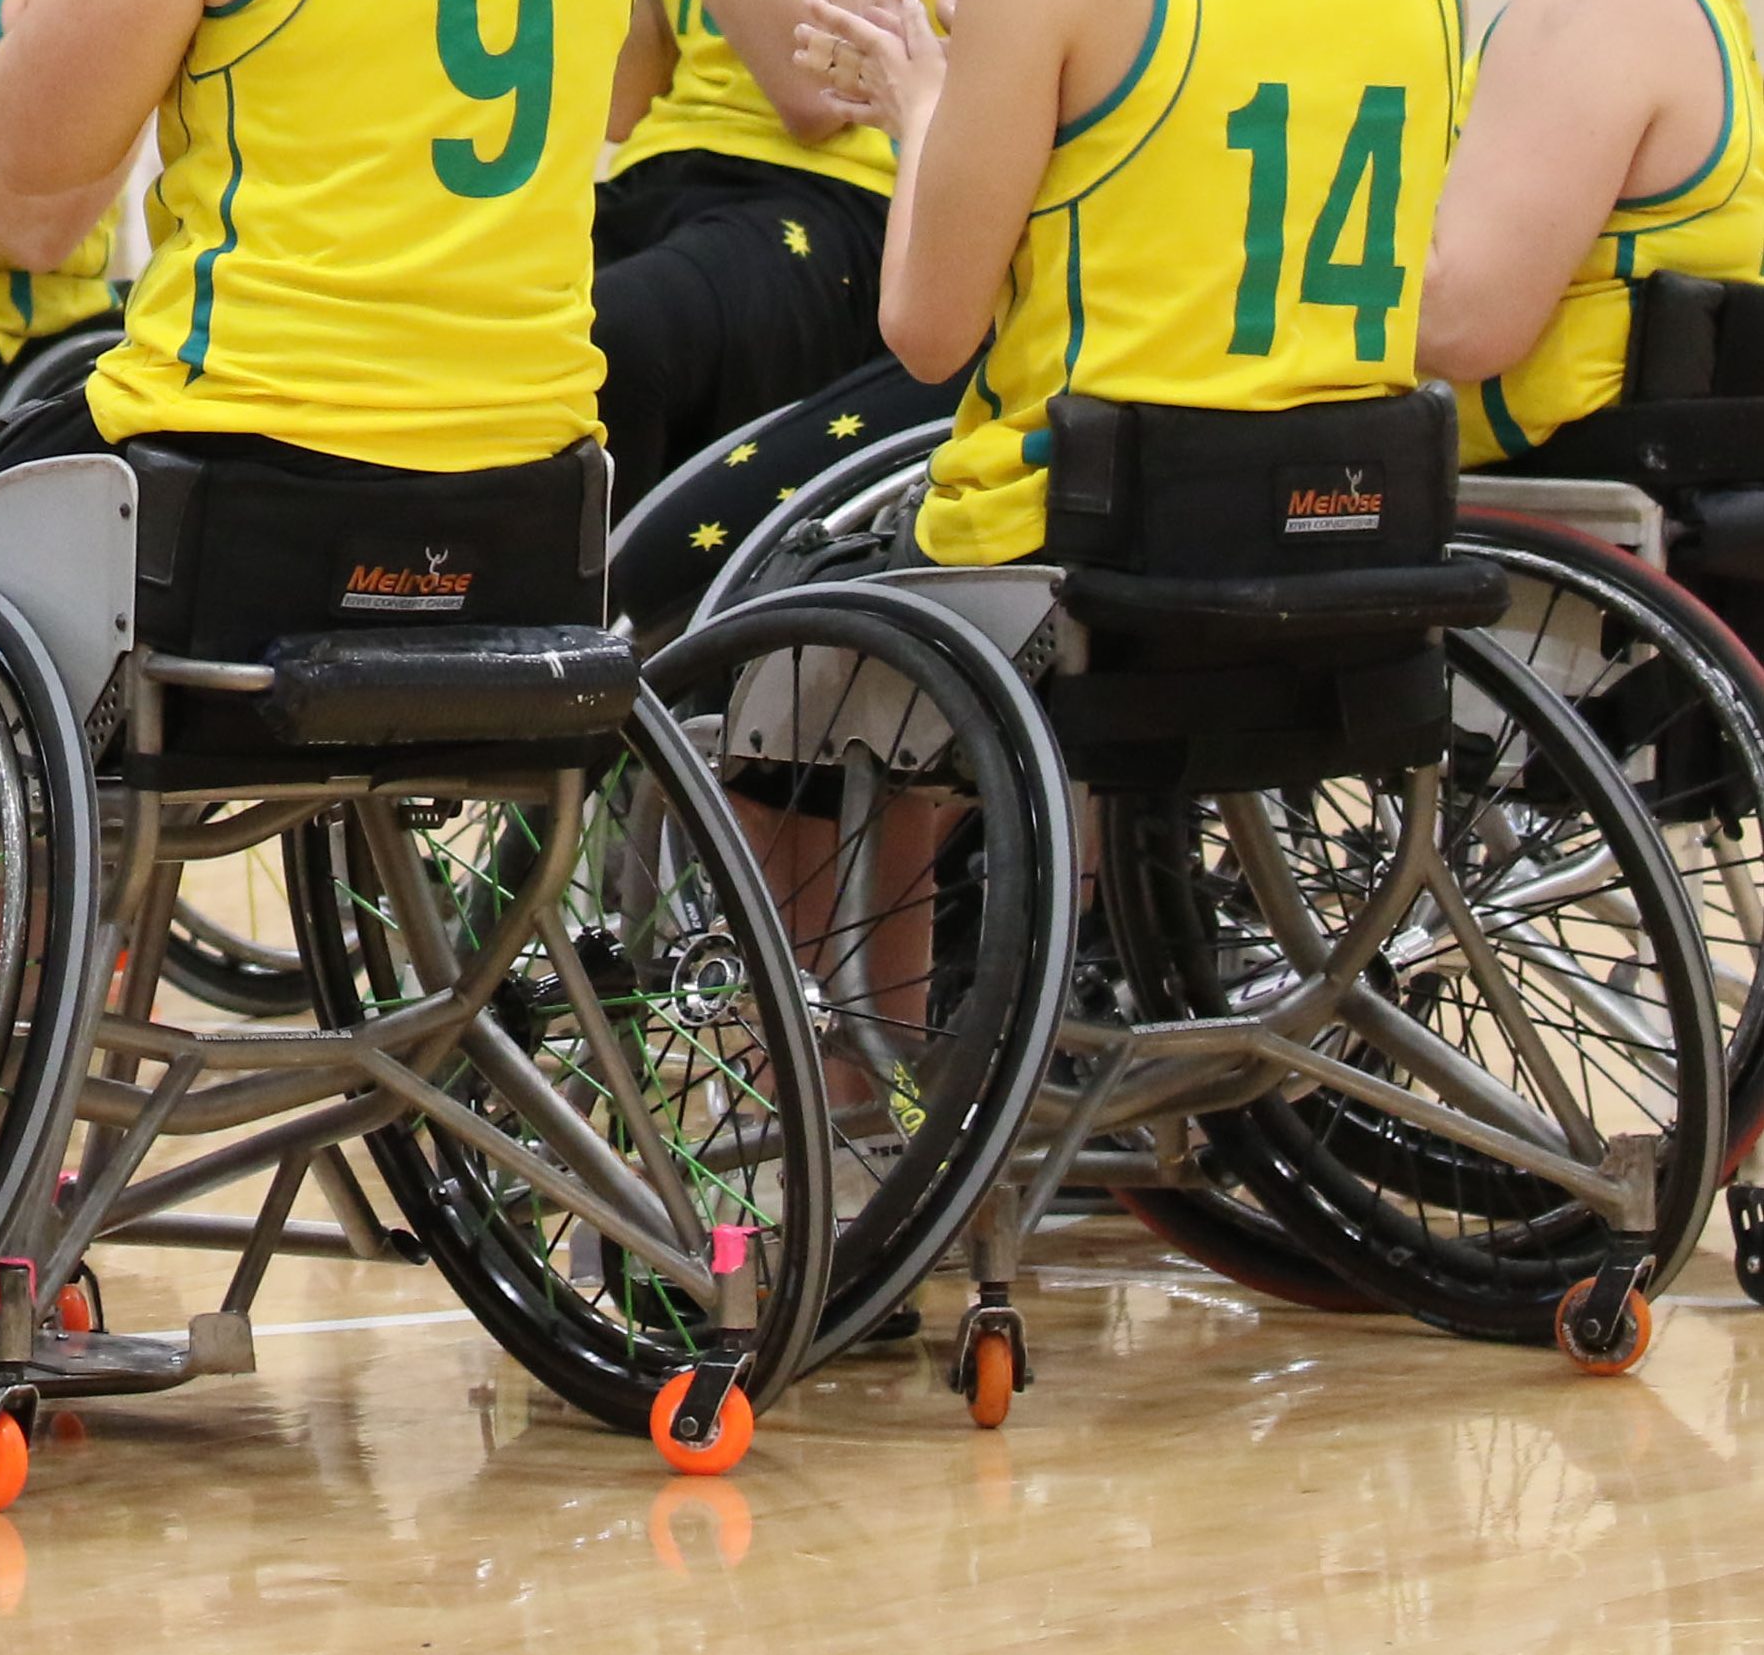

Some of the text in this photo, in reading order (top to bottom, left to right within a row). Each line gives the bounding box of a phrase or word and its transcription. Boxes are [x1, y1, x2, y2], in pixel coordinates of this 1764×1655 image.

[1226, 81, 1406, 362] 14
[1287, 489, 1383, 516] Melrose
[346, 565, 473, 594] Melrose
